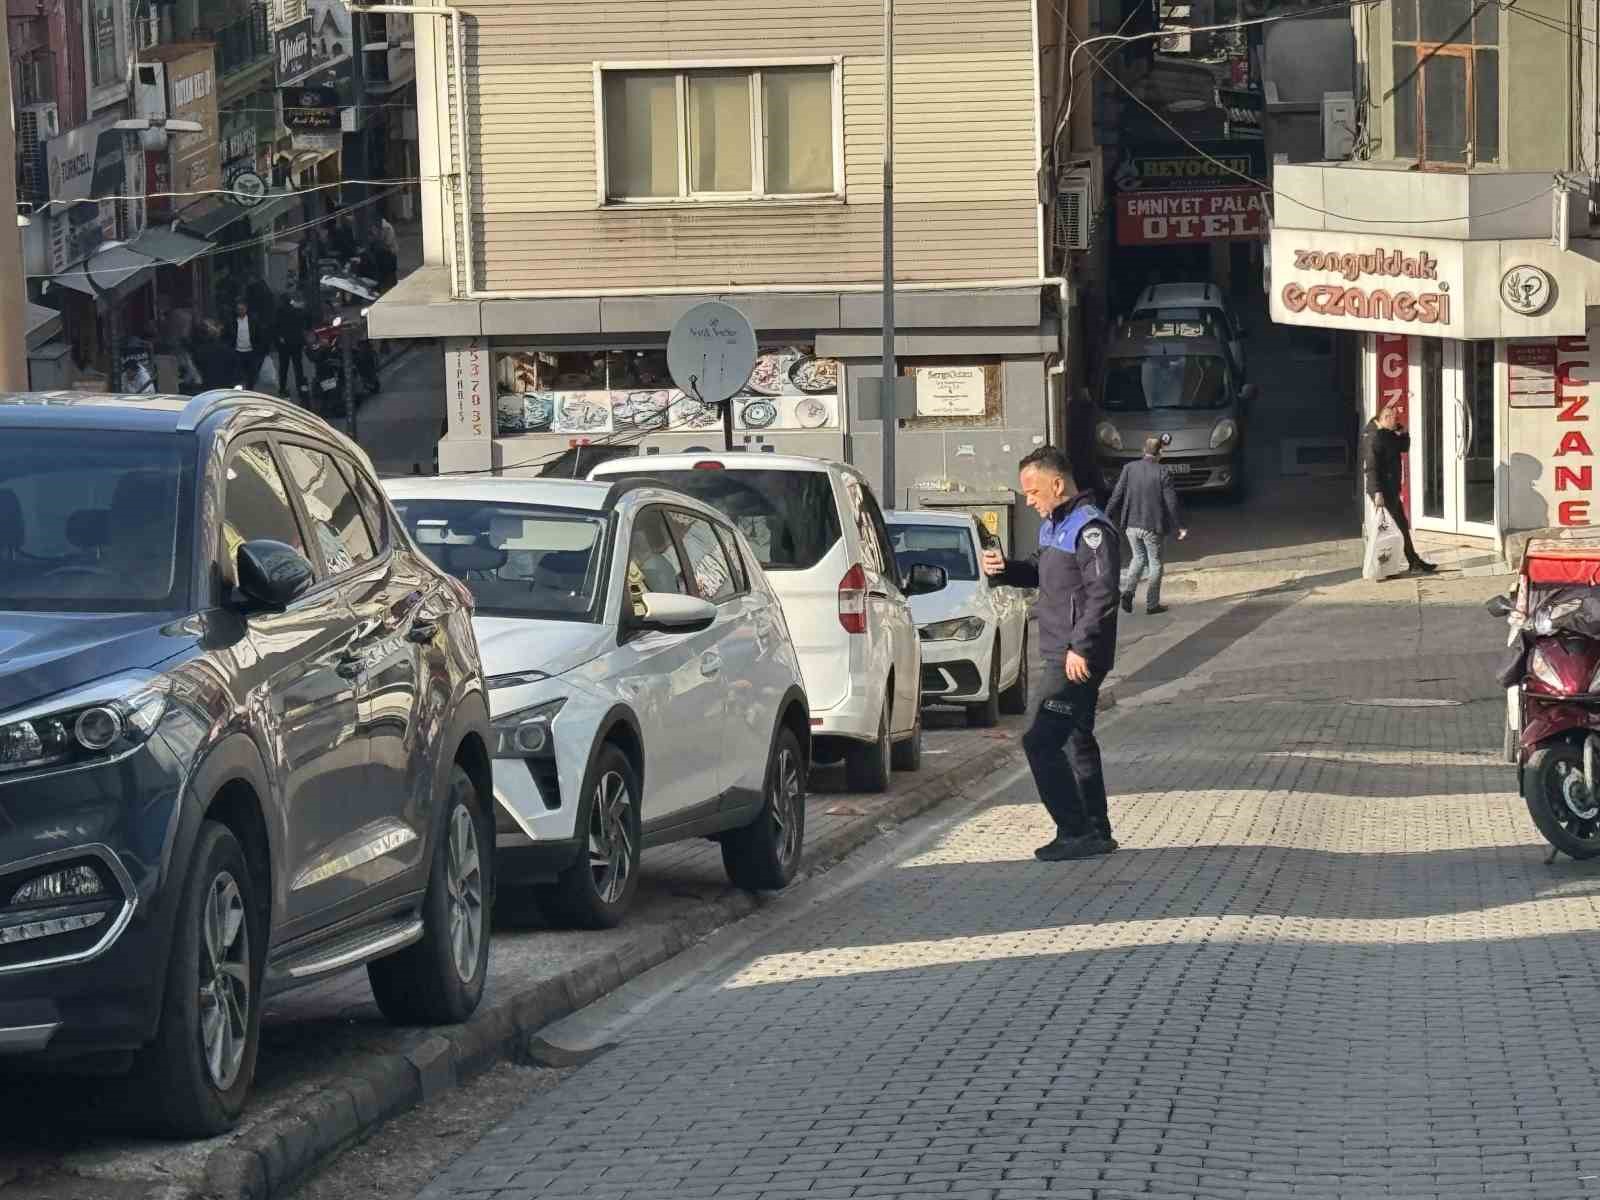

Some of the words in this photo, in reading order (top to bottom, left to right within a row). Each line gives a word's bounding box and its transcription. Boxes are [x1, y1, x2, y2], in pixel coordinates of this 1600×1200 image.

[1210, 195, 1264, 214] PALA
[1143, 214, 1260, 238] OTEL
[1294, 248, 1437, 281] zonguldak
[1282, 281, 1450, 325] eczanesi
[1553, 336, 1593, 526] ECZANE
